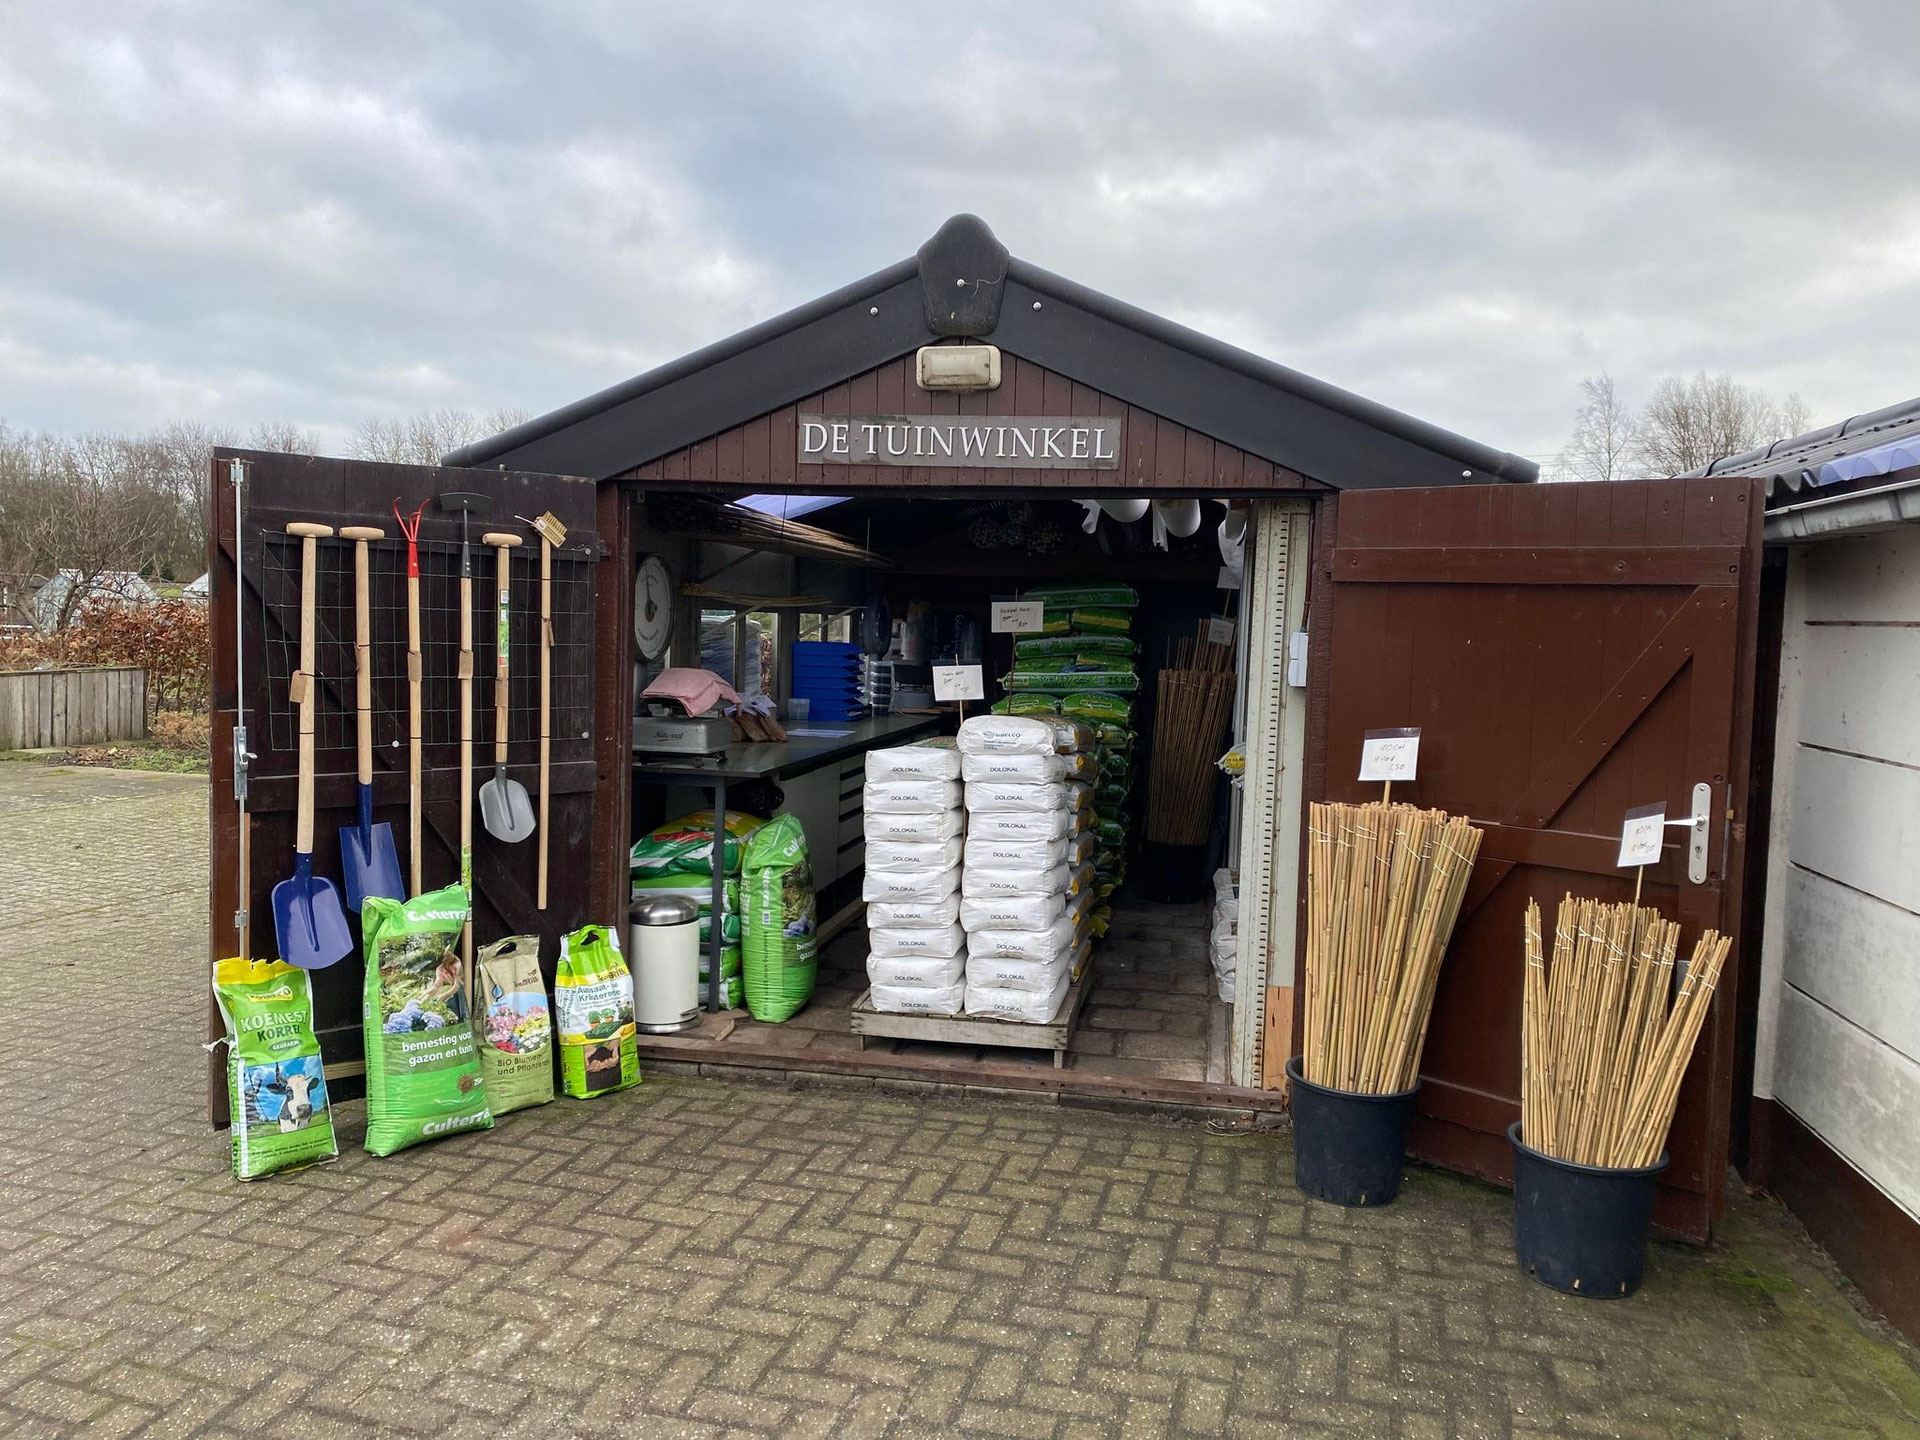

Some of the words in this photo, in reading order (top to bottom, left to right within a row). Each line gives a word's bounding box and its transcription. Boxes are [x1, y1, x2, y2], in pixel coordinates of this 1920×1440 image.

[803, 422, 849, 454] DE
[861, 424, 1115, 460] TUINWINKEL
[992, 851, 1022, 859] DOLOKAL
[407, 910, 467, 922] Clterra
[996, 943, 1026, 951] DOLOKAL
[996, 973, 1027, 981] DOLOKAL
[993, 1005, 1024, 1013] DOLOKAL
[240, 1010, 308, 1034] KOEMEST
[401, 1033, 457, 1053] bemesting
[408, 1051, 443, 1067] gazon
[445, 1048, 457, 1058] en
[458, 1043, 473, 1055] tuin
[497, 1066, 515, 1076] und
[422, 1107, 490, 1136] Culterra
